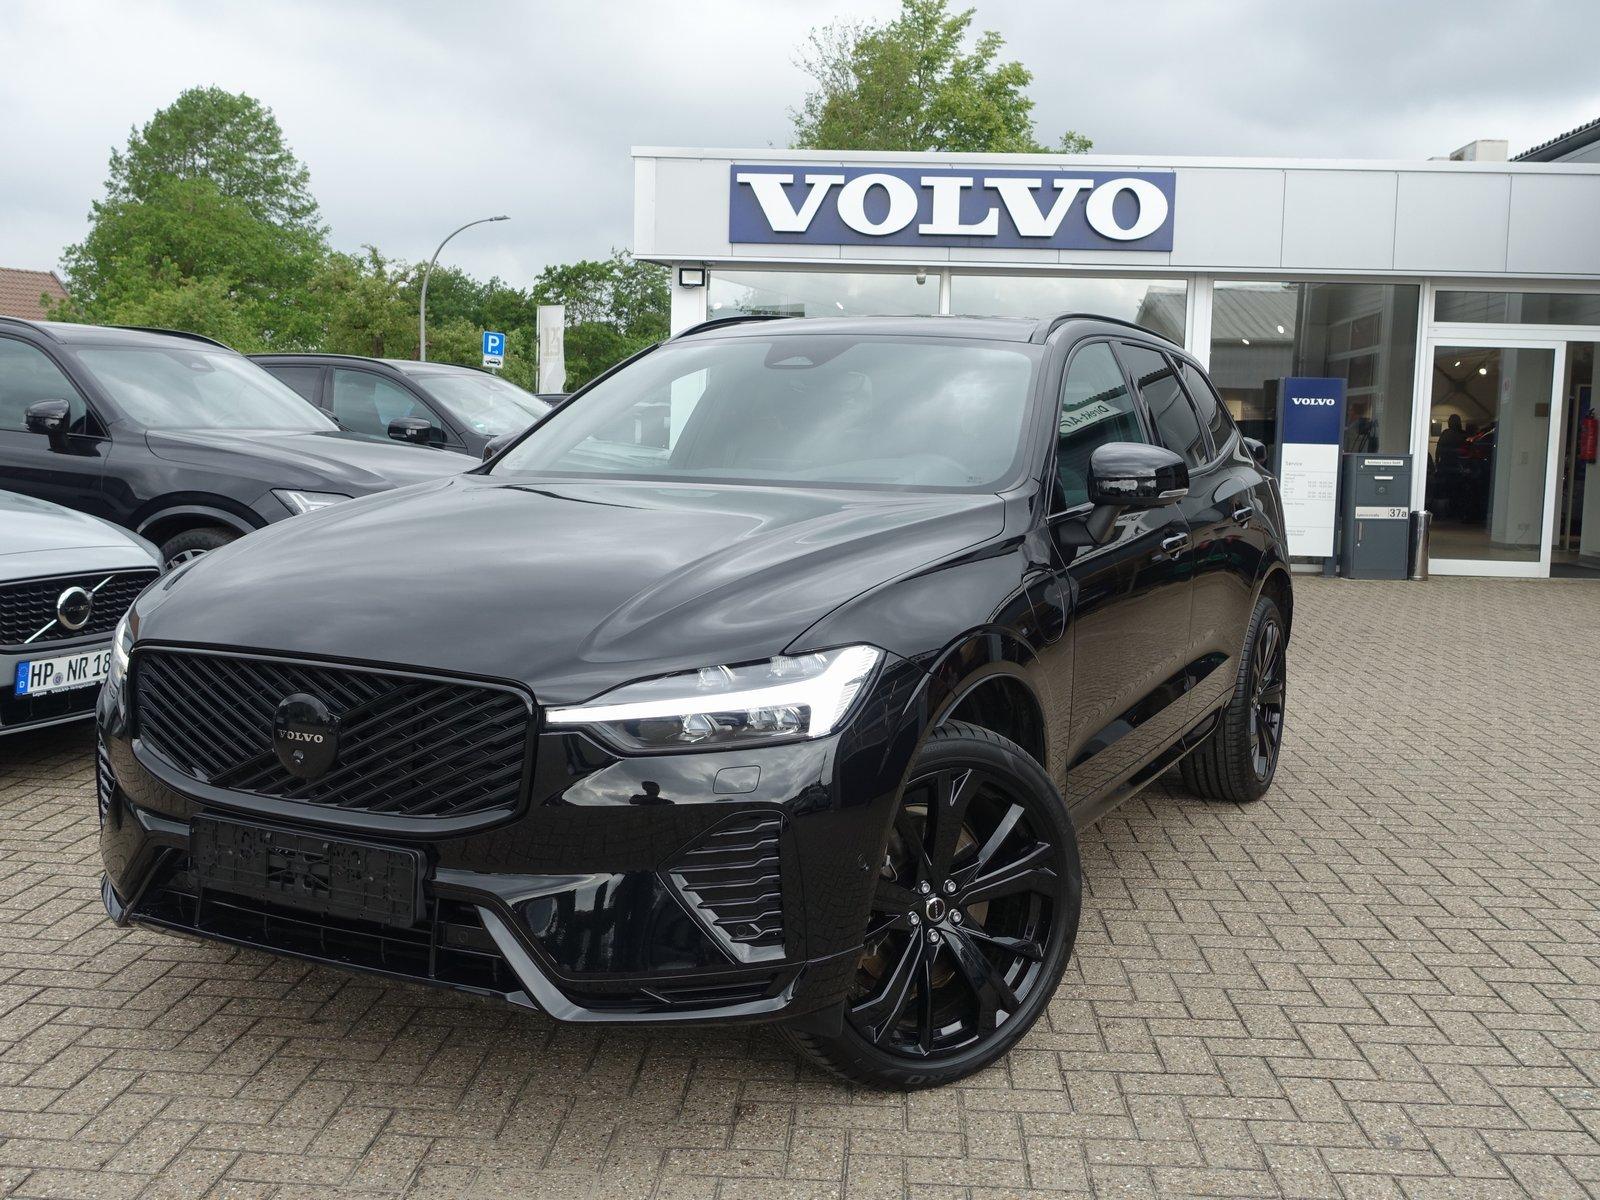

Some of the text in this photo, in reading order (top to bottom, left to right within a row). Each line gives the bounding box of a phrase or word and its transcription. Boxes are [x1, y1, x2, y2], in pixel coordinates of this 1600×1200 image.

[736, 172, 1169, 241] VOLVO
[487, 334, 500, 353] P
[1291, 397, 1336, 406] VOLVO
[1389, 508, 1407, 518] 37a
[30, 662, 54, 687] HP
[66, 657, 89, 682] NR
[278, 729, 324, 743] VOLVO
